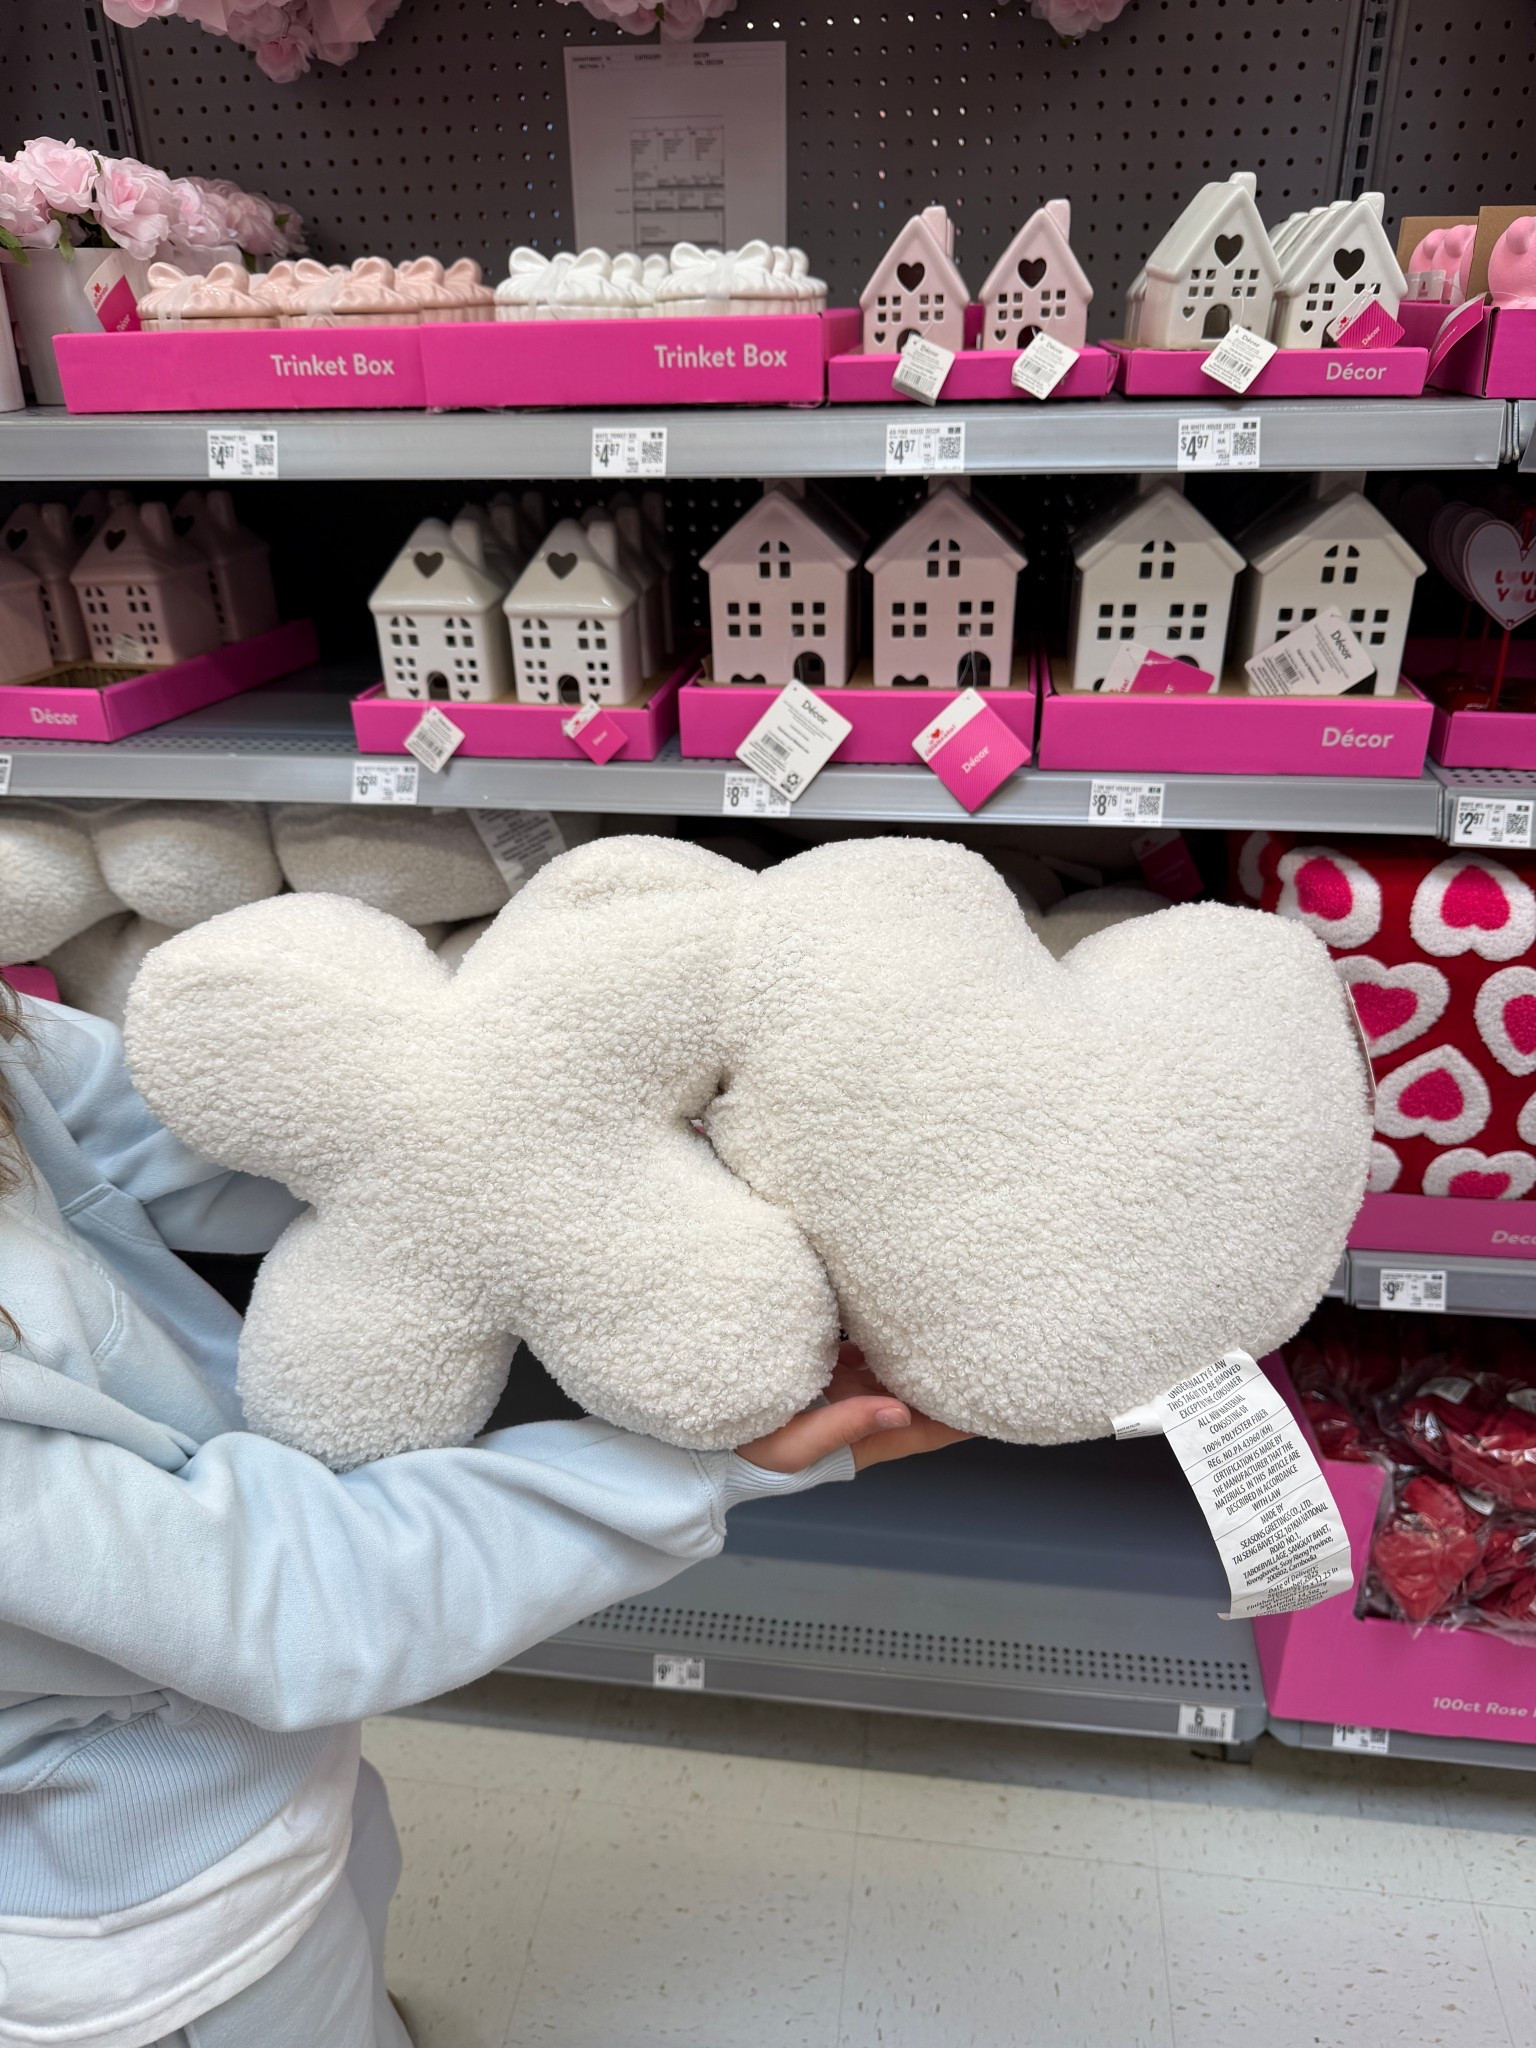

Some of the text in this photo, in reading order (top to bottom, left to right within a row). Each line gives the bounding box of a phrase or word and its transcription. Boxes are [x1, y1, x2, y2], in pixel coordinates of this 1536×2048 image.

[1362, 326, 1380, 345] Décor
[270, 353, 395, 376] Trinket Box
[654, 343, 787, 368] Trinket Box
[1326, 362, 1387, 380] Décor
[1331, 630, 1352, 660] Décor
[30, 707, 78, 724] Décor
[1321, 727, 1394, 748] Décor
[961, 746, 990, 774] Décor
[1211, 1359, 1227, 1373] LAW
[1167, 1398, 1184, 1412] THIS
[1181, 1391, 1195, 1404] TAG
[1198, 1386, 1207, 1396] TO
[1207, 1380, 1216, 1391] BE
[1179, 1401, 1202, 1419] EXCEPT
[1213, 1375, 1243, 1401] CONSUMER
[1198, 1416, 1211, 1428] ALL
[1202, 1408, 1269, 1454] 100% POLYESTER FIBER
[1209, 1408, 1240, 1434] CONSISTING
[1207, 1456, 1223, 1469] REG.
[1242, 1432, 1260, 1448] 43960
[1260, 1423, 1273, 1438] (KH)
[1213, 1434, 1283, 1483] CERTIFICATION IS MADE BY
[1212, 1441, 1294, 1497] THE MANUFACTURER THAT THE
[1214, 1450, 1301, 1510] MATERIALS IN THIS ARTICLE ARE
[1226, 1464, 1299, 1516] DESCRIBED IN ACCORDANCE
[1252, 1488, 1281, 1511] WITH LAW
[1260, 1503, 1284, 1525] MADE BY
[1232, 1553, 1243, 1565] TAI
[1241, 1546, 1258, 1560] SENG
[1257, 1535, 1275, 1552] BAVET
[1301, 1502, 1328, 1524] NATIONAL
[1240, 1529, 1266, 1549] SEASONS
[1264, 1511, 1291, 1535] GREETINGS
[1287, 1535, 1313, 1554] SANGKAT
[1311, 1524, 1331, 1542] BAVET,
[1246, 1536, 1333, 1587] Krongbavet, Svay Rieng Province,
[1269, 1541, 1285, 1554] ROAD
[1267, 1554, 1317, 1584] 200802, Cambodia
[1268, 1582, 1283, 1593] Date
[1283, 1577, 1290, 1586] of
[1290, 1564, 1318, 1582] Delivery:
[1433, 1697, 1481, 1713] 100ct
[1486, 1702, 1528, 1717] Rose
